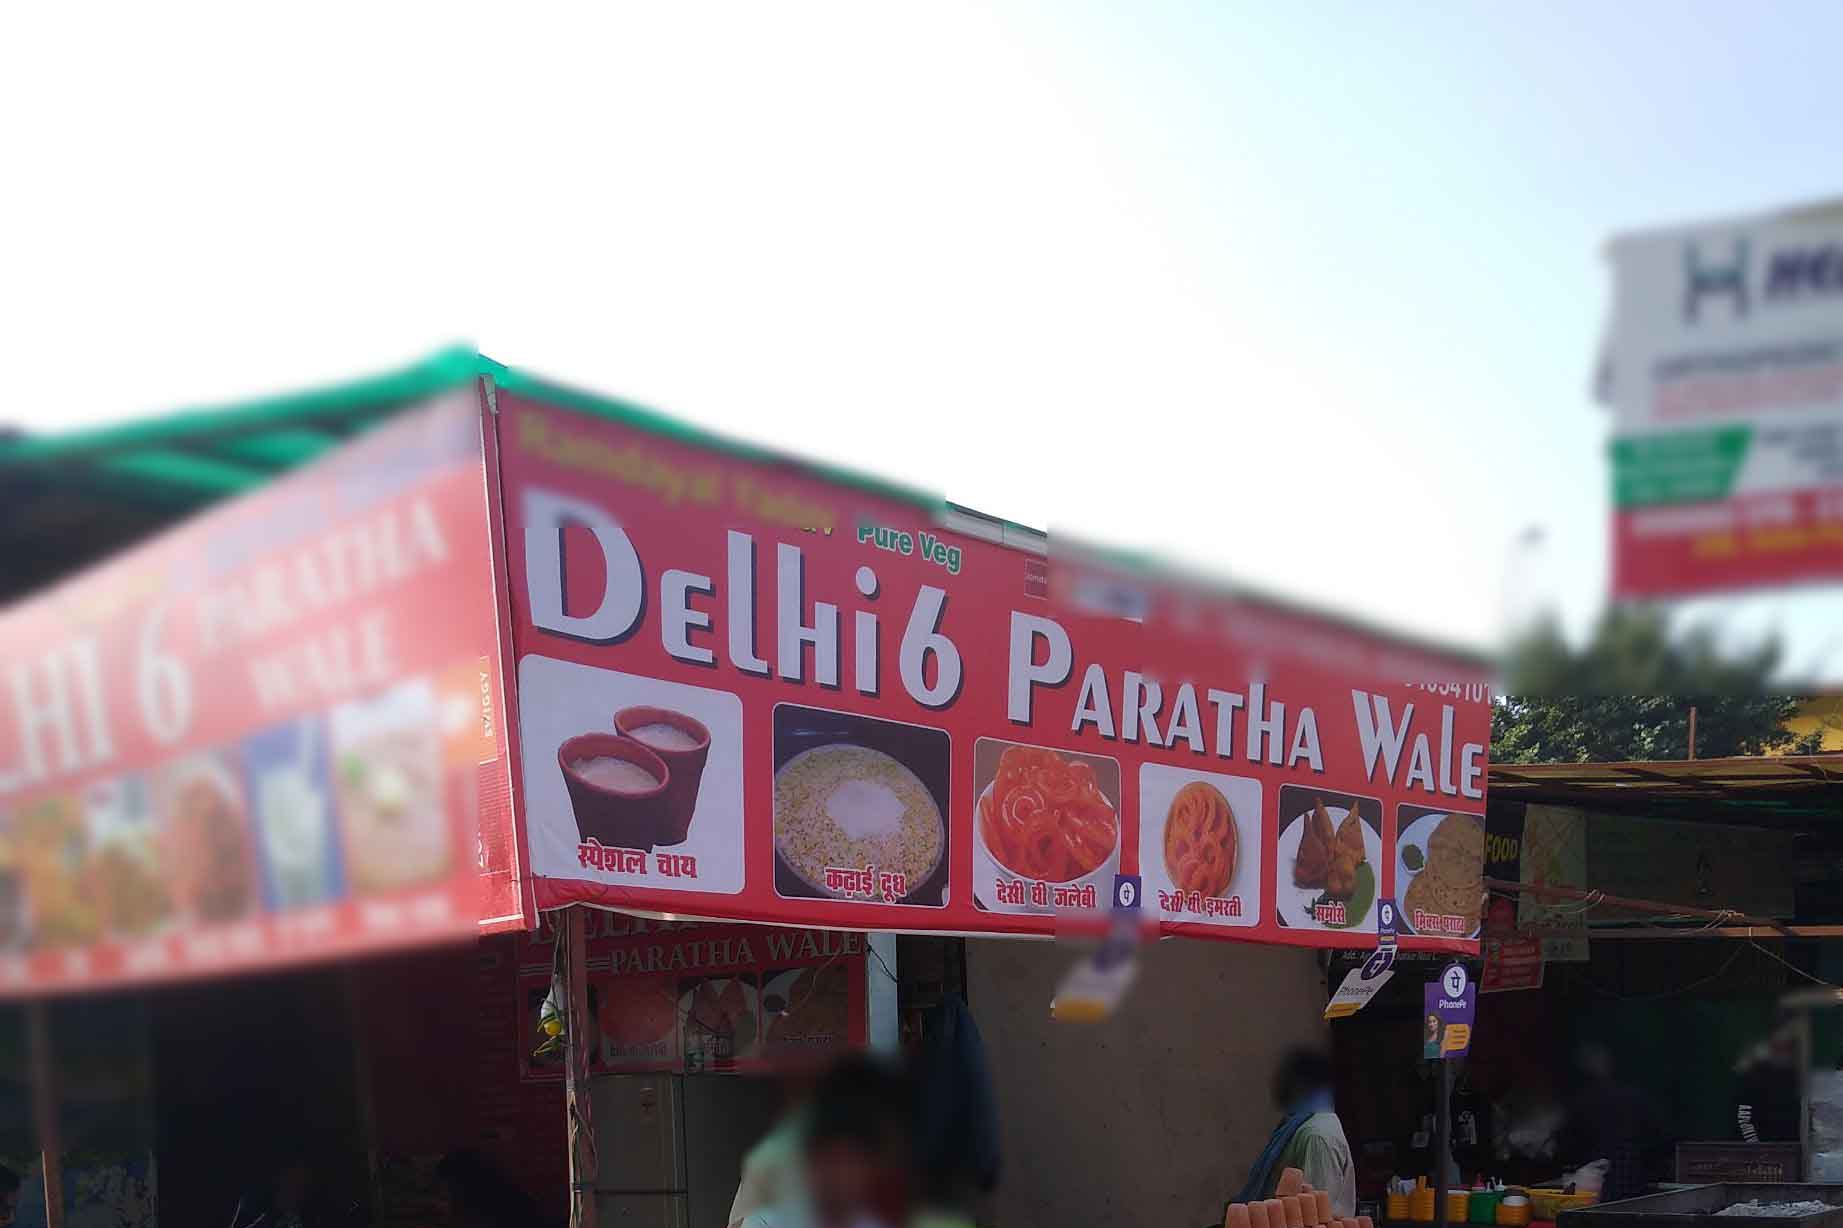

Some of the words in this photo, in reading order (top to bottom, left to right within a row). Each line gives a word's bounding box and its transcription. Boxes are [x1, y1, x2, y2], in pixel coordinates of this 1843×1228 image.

[919, 530, 962, 575] Veg
[577, 838, 648, 876] स्पेशल
[655, 850, 698, 879] चाय
[995, 879, 1026, 906] देसी
[1031, 881, 1051, 907] घी
[1054, 883, 1098, 909] जलेबी
[606, 936, 755, 976] PARATHA
[765, 931, 863, 961] WALE
